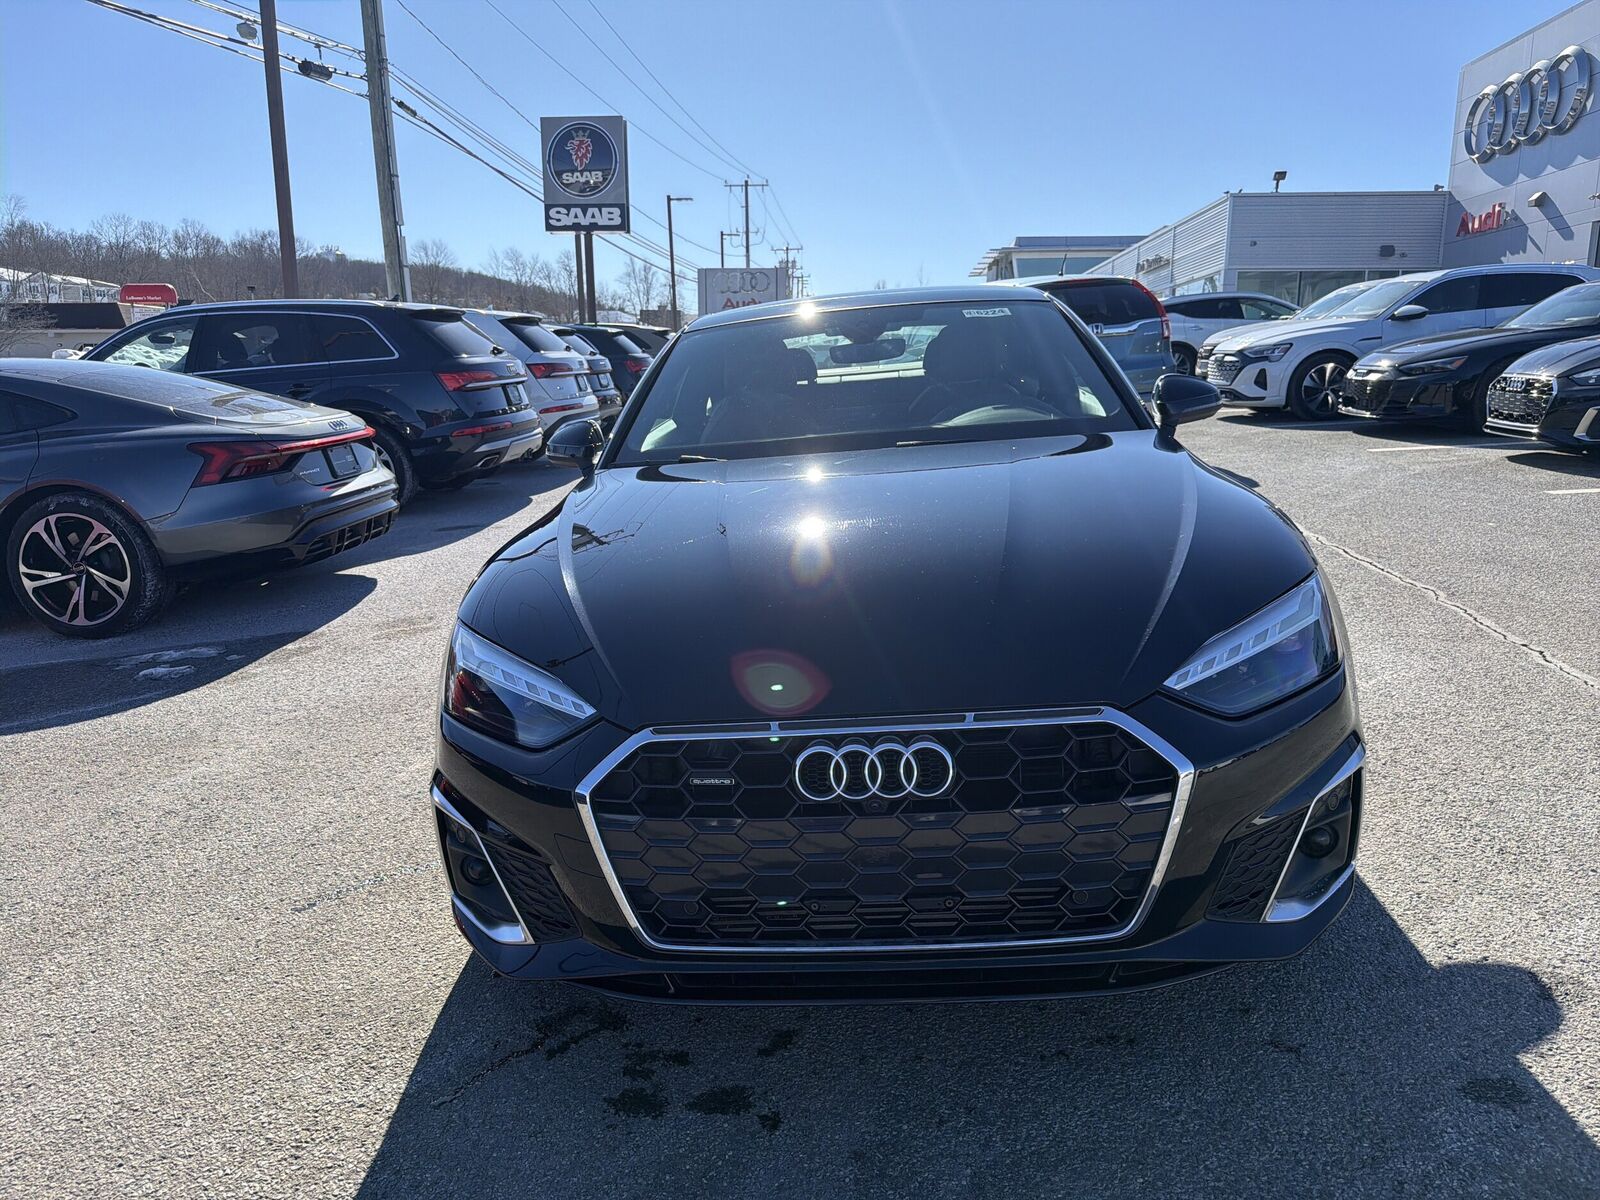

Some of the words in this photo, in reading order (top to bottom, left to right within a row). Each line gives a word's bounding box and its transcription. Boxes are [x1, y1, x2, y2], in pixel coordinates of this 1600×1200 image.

[561, 171, 603, 184] SAAB
[548, 207, 622, 226] SAAB
[1456, 202, 1506, 237] Audi
